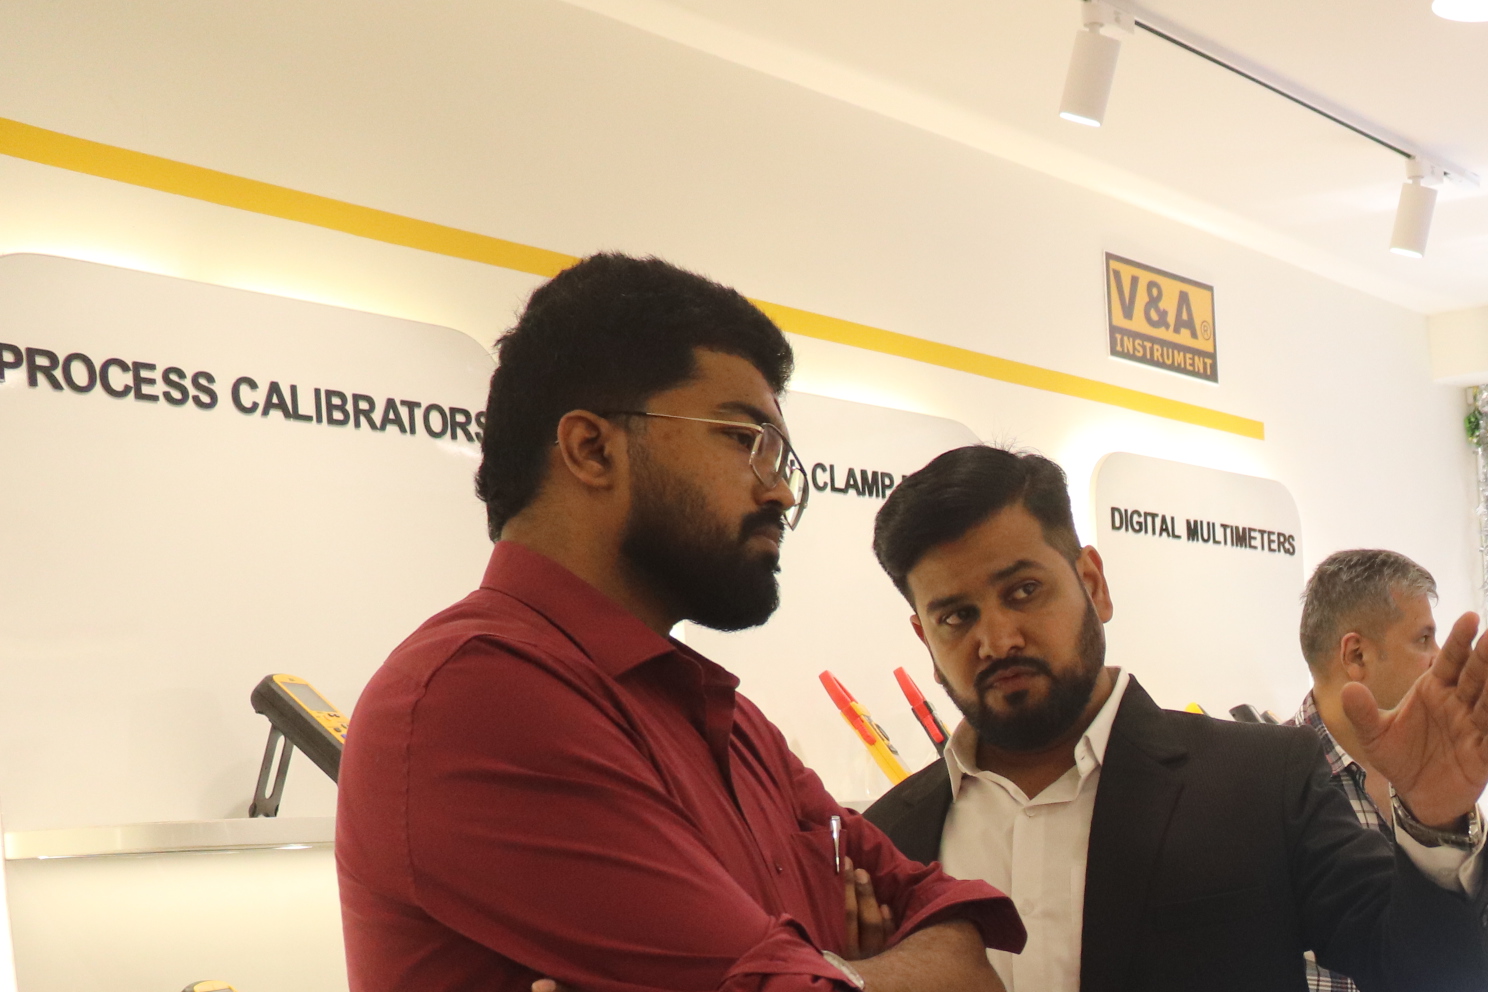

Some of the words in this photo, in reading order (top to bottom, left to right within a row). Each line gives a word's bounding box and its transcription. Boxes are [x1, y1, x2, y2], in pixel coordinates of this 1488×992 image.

[0, 342, 219, 410] PROCESS
[1115, 333, 1213, 375] INSTRUMENT
[811, 462, 895, 499] CLAMP
[1110, 506, 1182, 539] DIGITAL
[1186, 519, 1296, 556] MULTIMETERS
